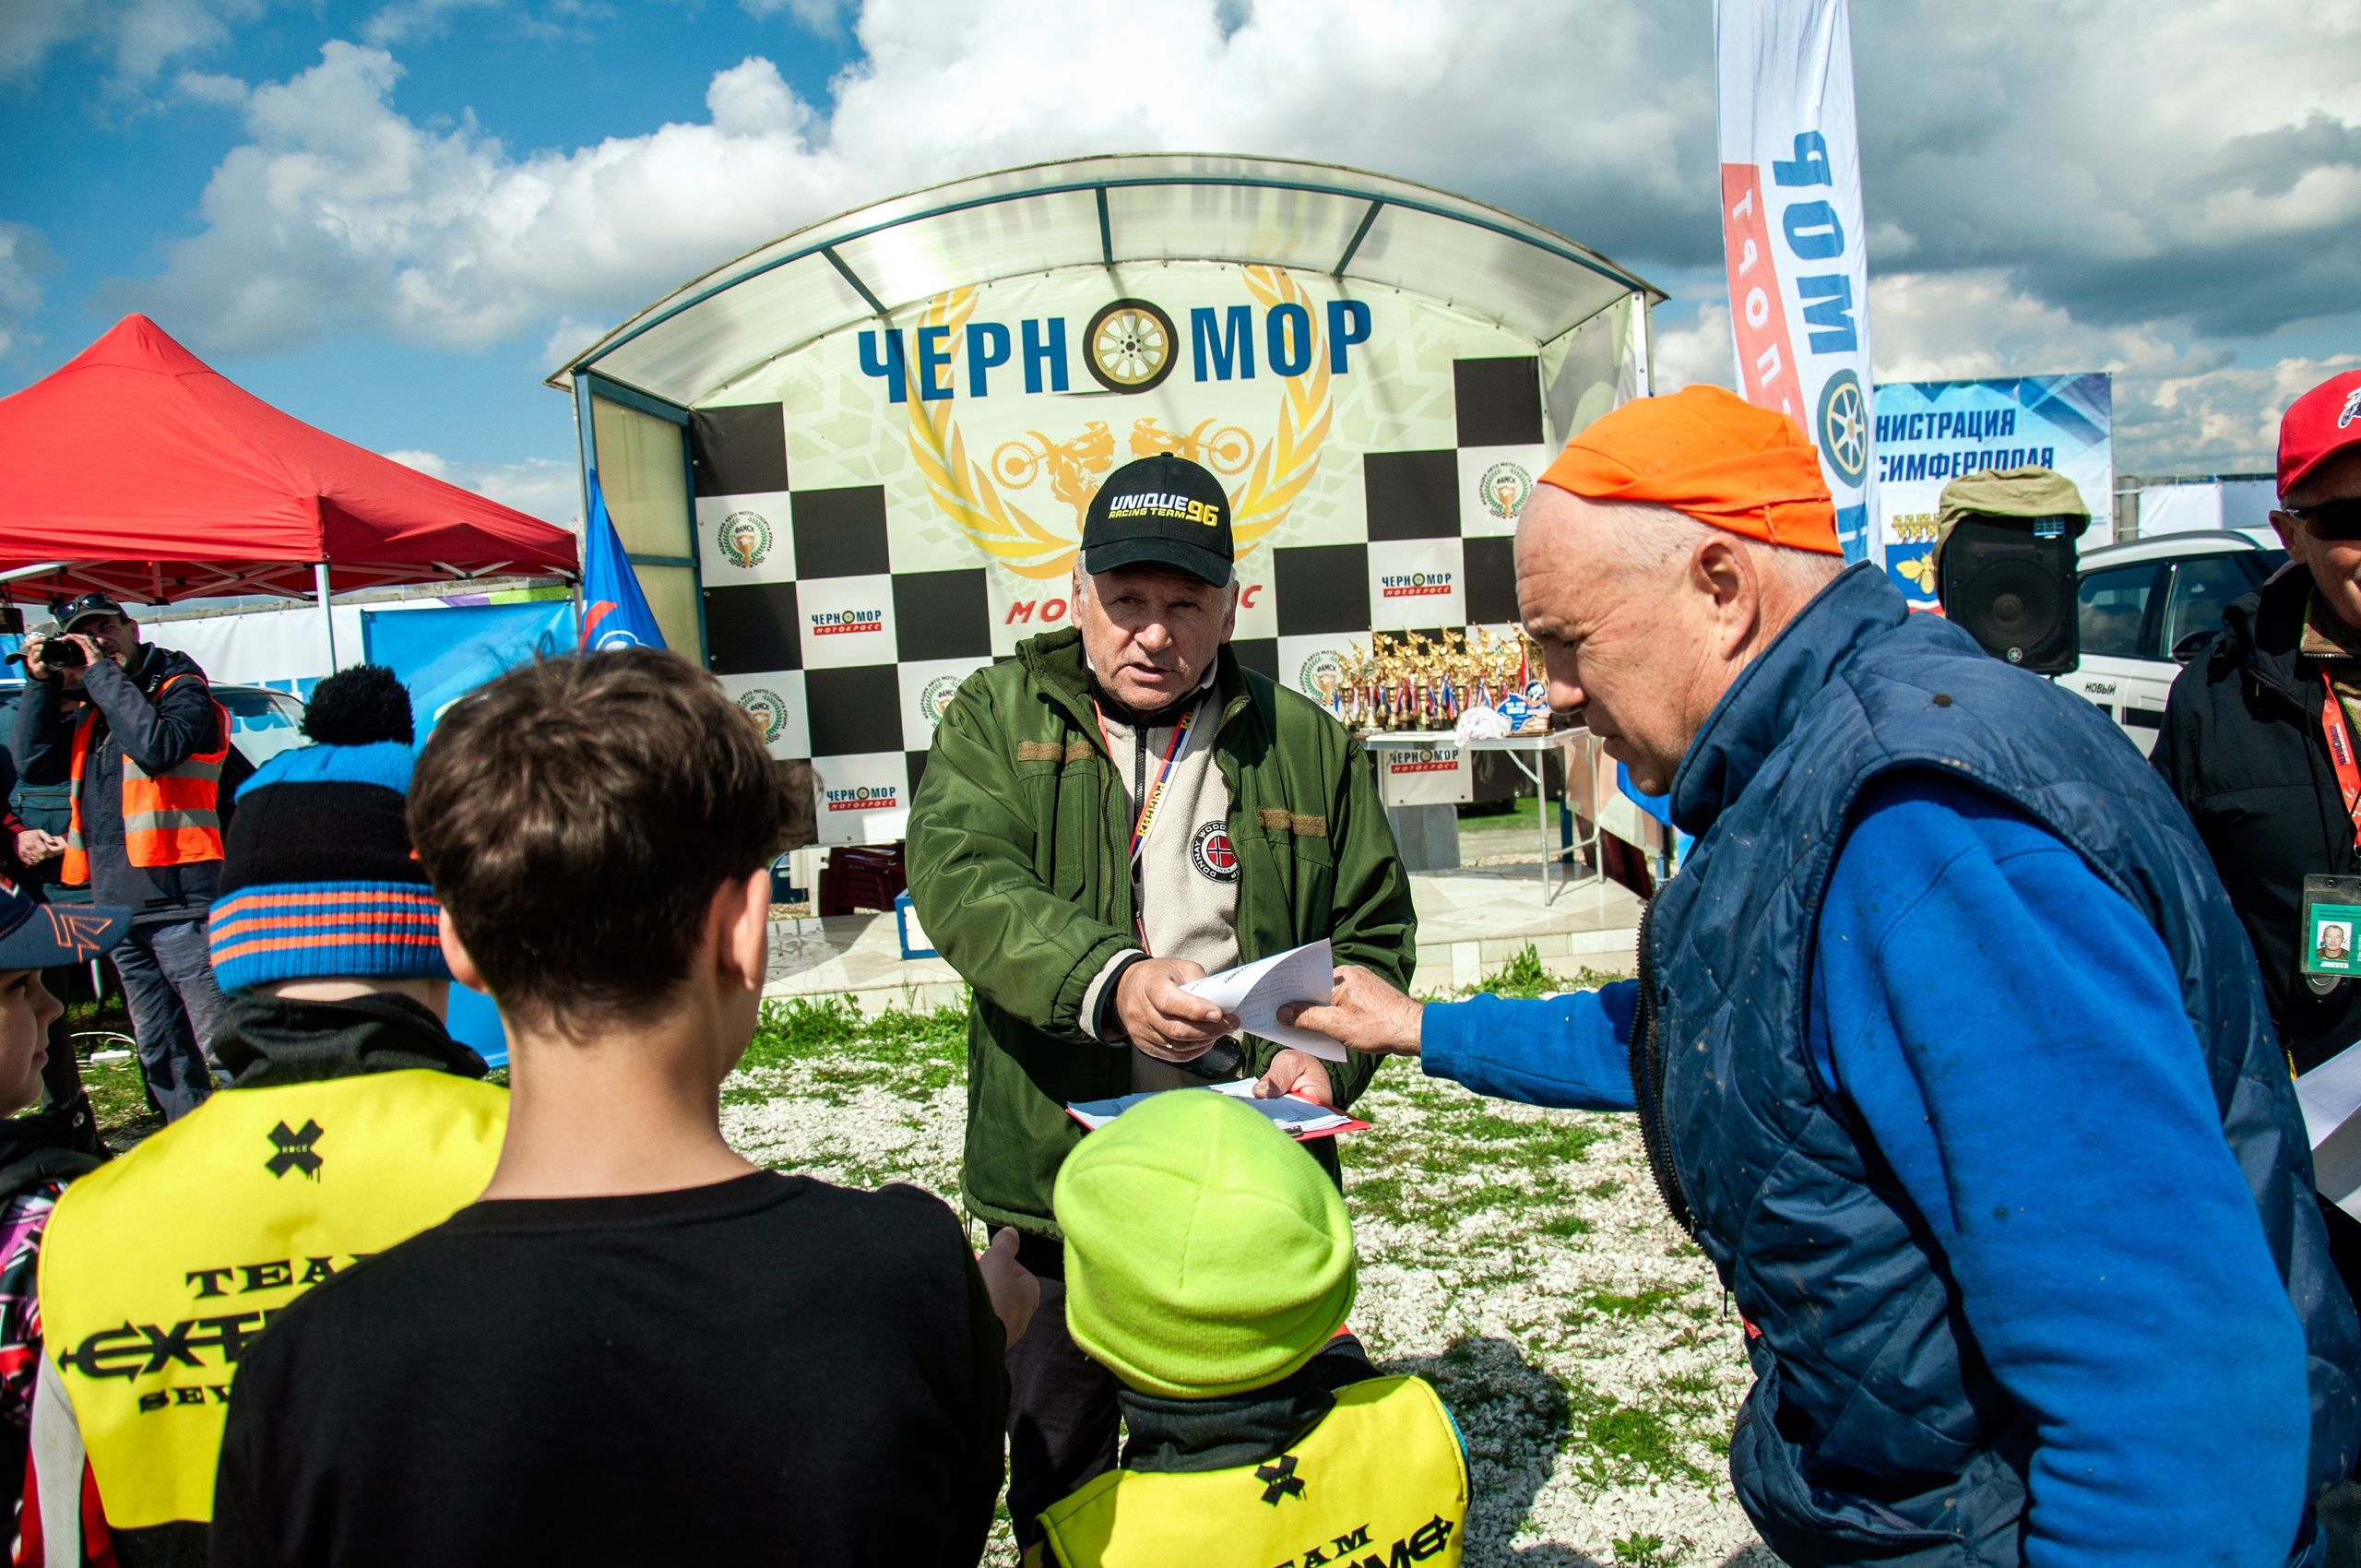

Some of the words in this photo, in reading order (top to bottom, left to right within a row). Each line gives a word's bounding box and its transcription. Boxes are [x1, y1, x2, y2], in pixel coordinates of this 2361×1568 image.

[1876, 408, 2016, 443] НИСТРАЦИЯ
[1108, 507, 1147, 519] RACING
[1150, 507, 1186, 519] TEAM
[1109, 493, 1189, 511] UNIQUE
[1185, 500, 1219, 528] 96
[1386, 587, 1450, 596] МОТОКРОСС
[816, 624, 880, 634] МОТОКРОСС
[938, 689, 956, 698] ФАМС
[2084, 682, 2118, 695] НОВЫЙ
[1394, 763, 1456, 772] МОТОКРОСС
[831, 800, 895, 810] МОТОКРОСС
[1137, 781, 1165, 837] РОССИЯ
[1193, 839, 1216, 878] DONNAY
[185, 1253, 376, 1300] TEA
